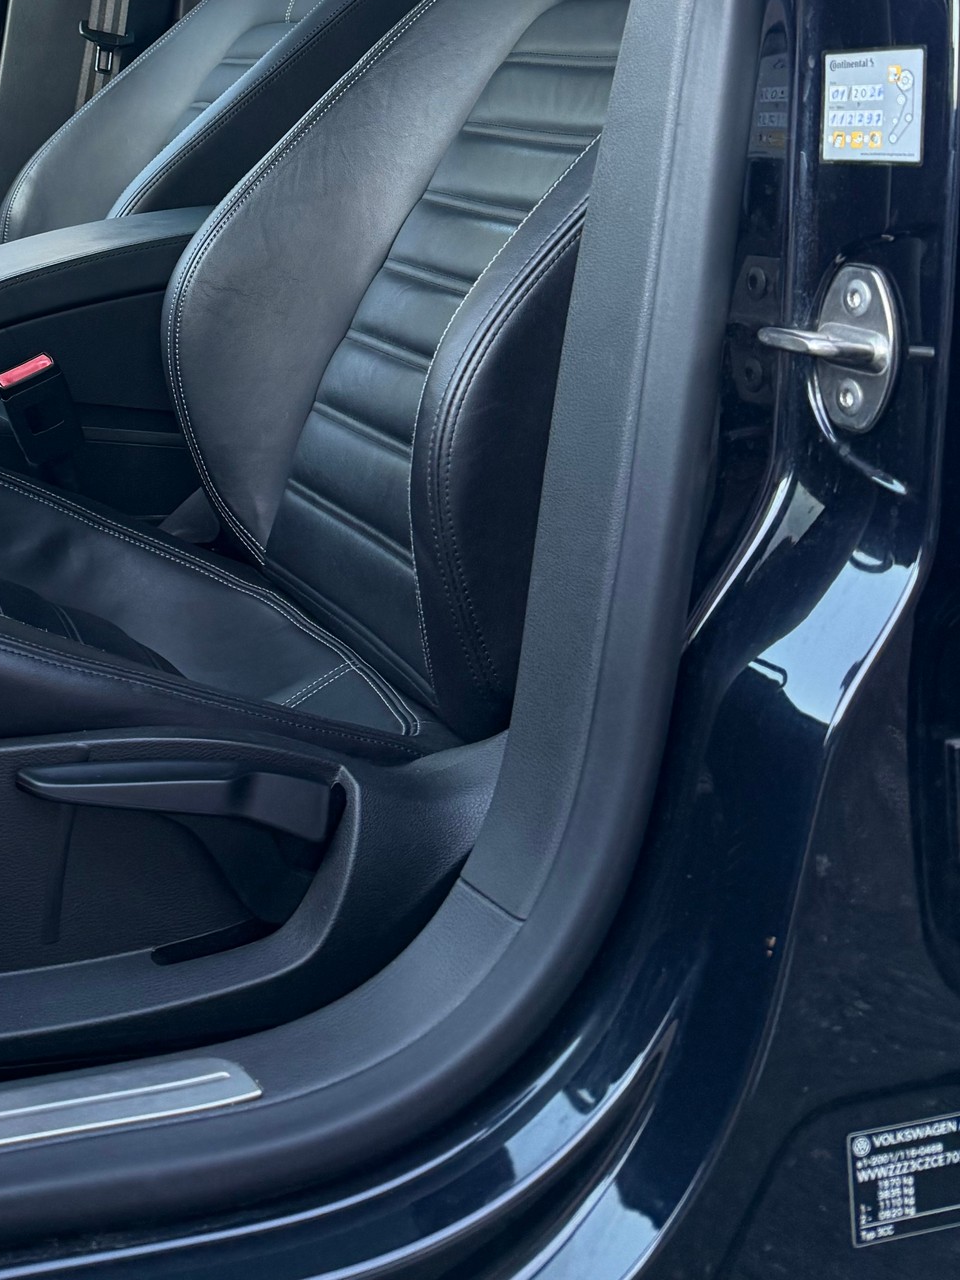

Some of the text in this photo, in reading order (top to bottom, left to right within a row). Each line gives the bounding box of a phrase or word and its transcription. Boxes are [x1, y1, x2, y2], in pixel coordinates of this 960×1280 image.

[829, 58, 868, 72] Continental
[872, 1120, 957, 1148] VOLKSWAGEN
[856, 1150, 960, 1183] WVWZZZ3CZCE70
